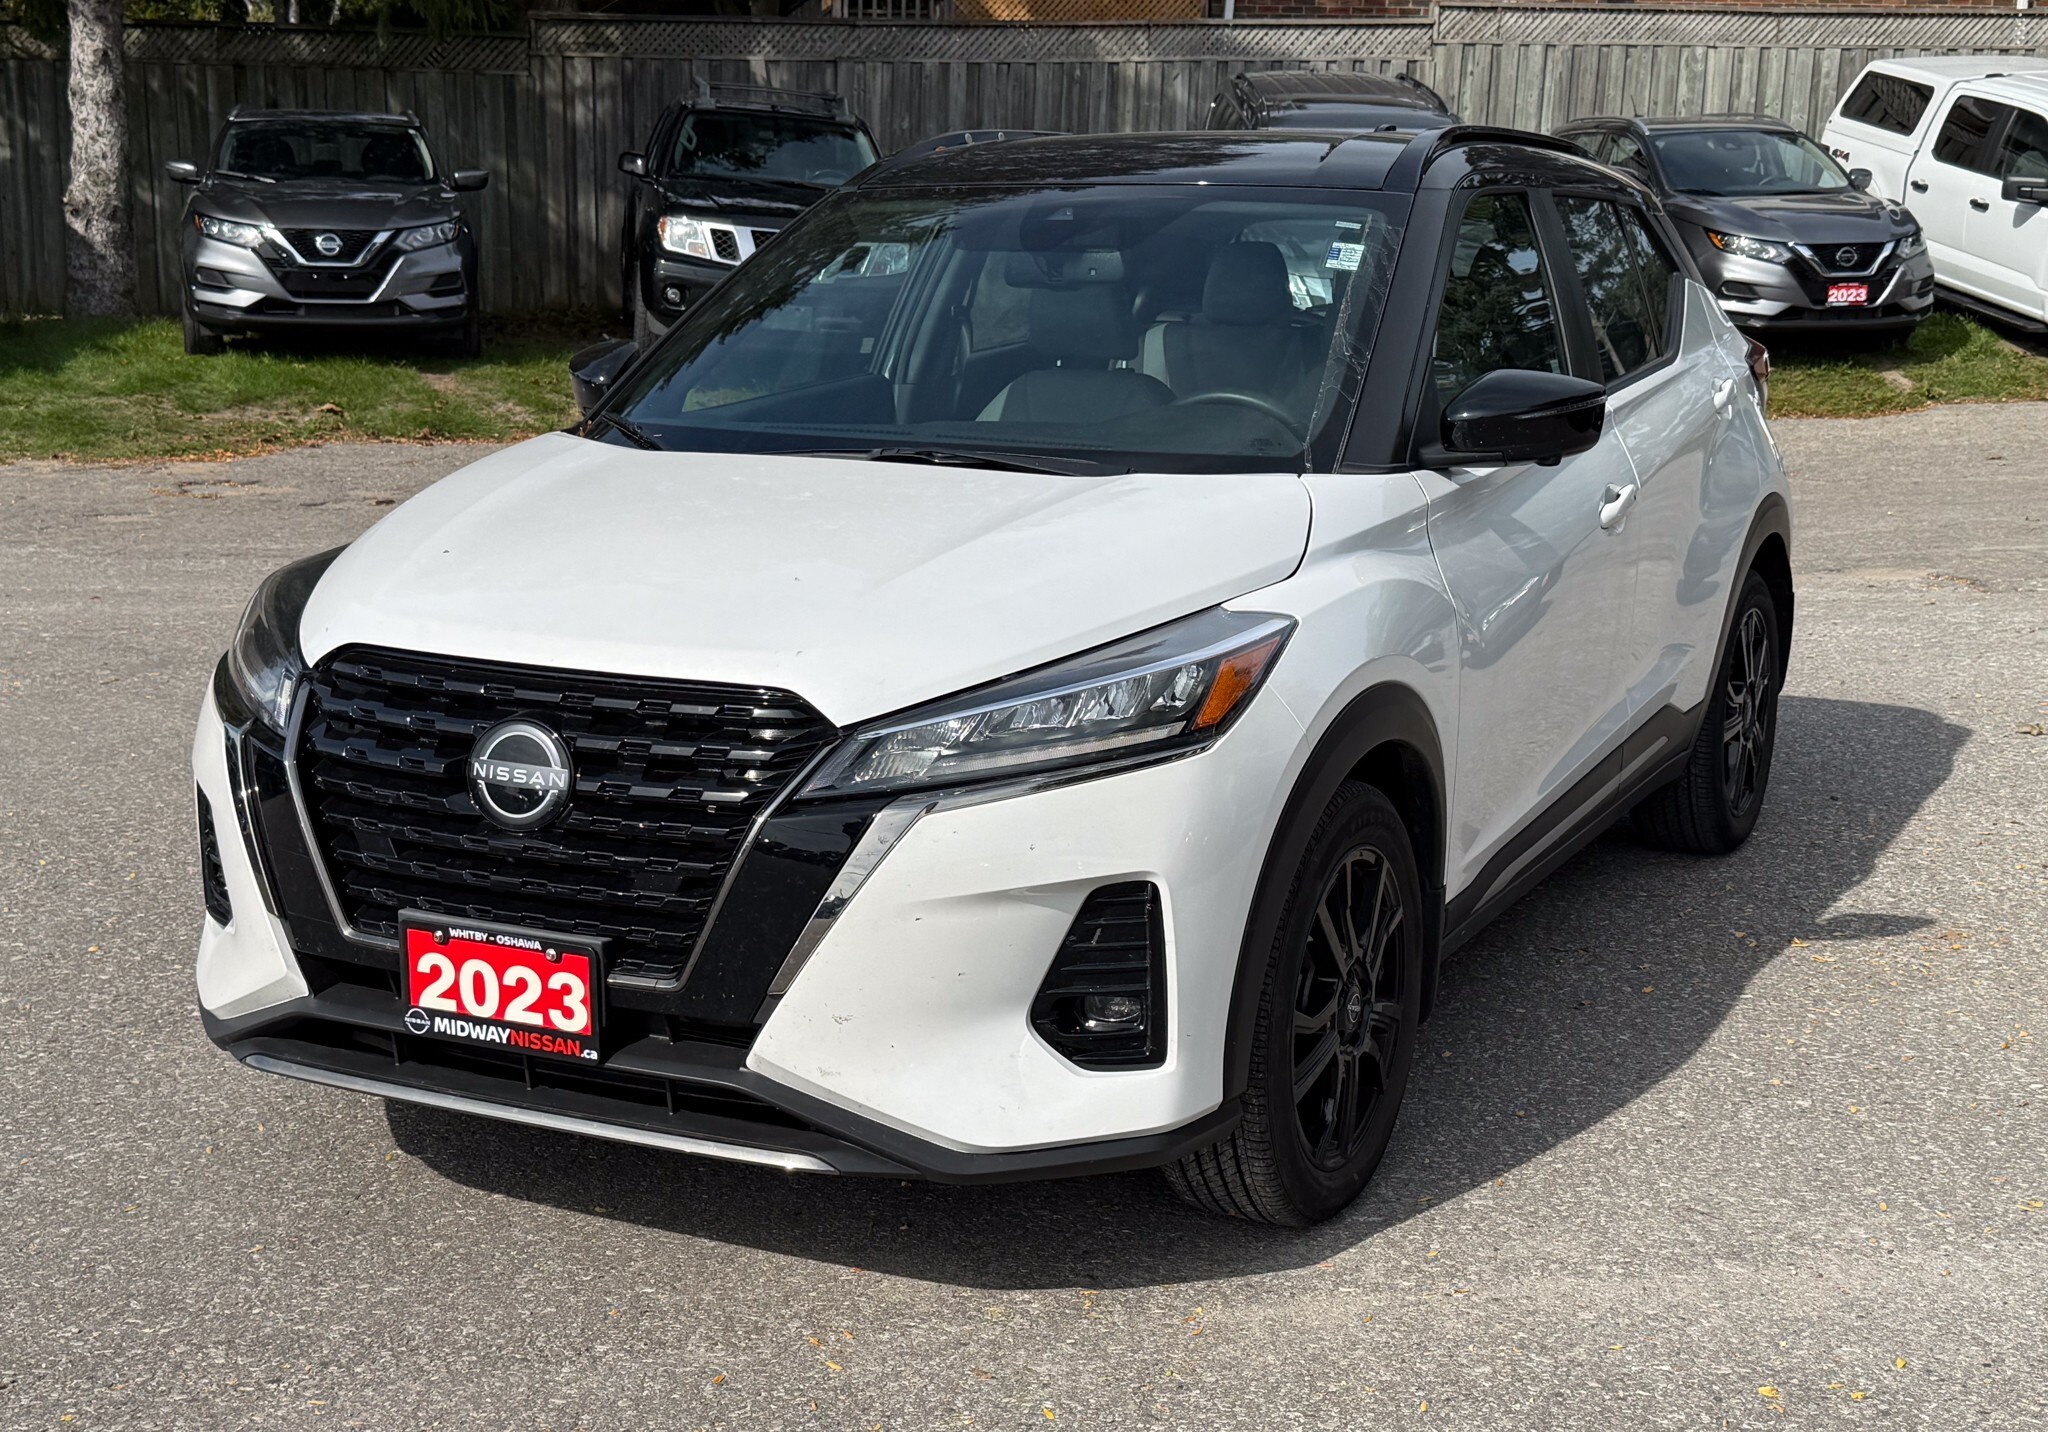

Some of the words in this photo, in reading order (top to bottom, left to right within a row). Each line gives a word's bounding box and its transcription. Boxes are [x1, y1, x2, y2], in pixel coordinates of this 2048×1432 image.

[1828, 288, 1867, 302] 2023
[473, 762, 565, 788] NISSAN
[449, 928, 488, 942] WHITBY
[496, 935, 542, 950] OSHAWA
[417, 952, 588, 1032] 2023
[434, 1017, 598, 1060] MIDWAYNISSAN.ca
